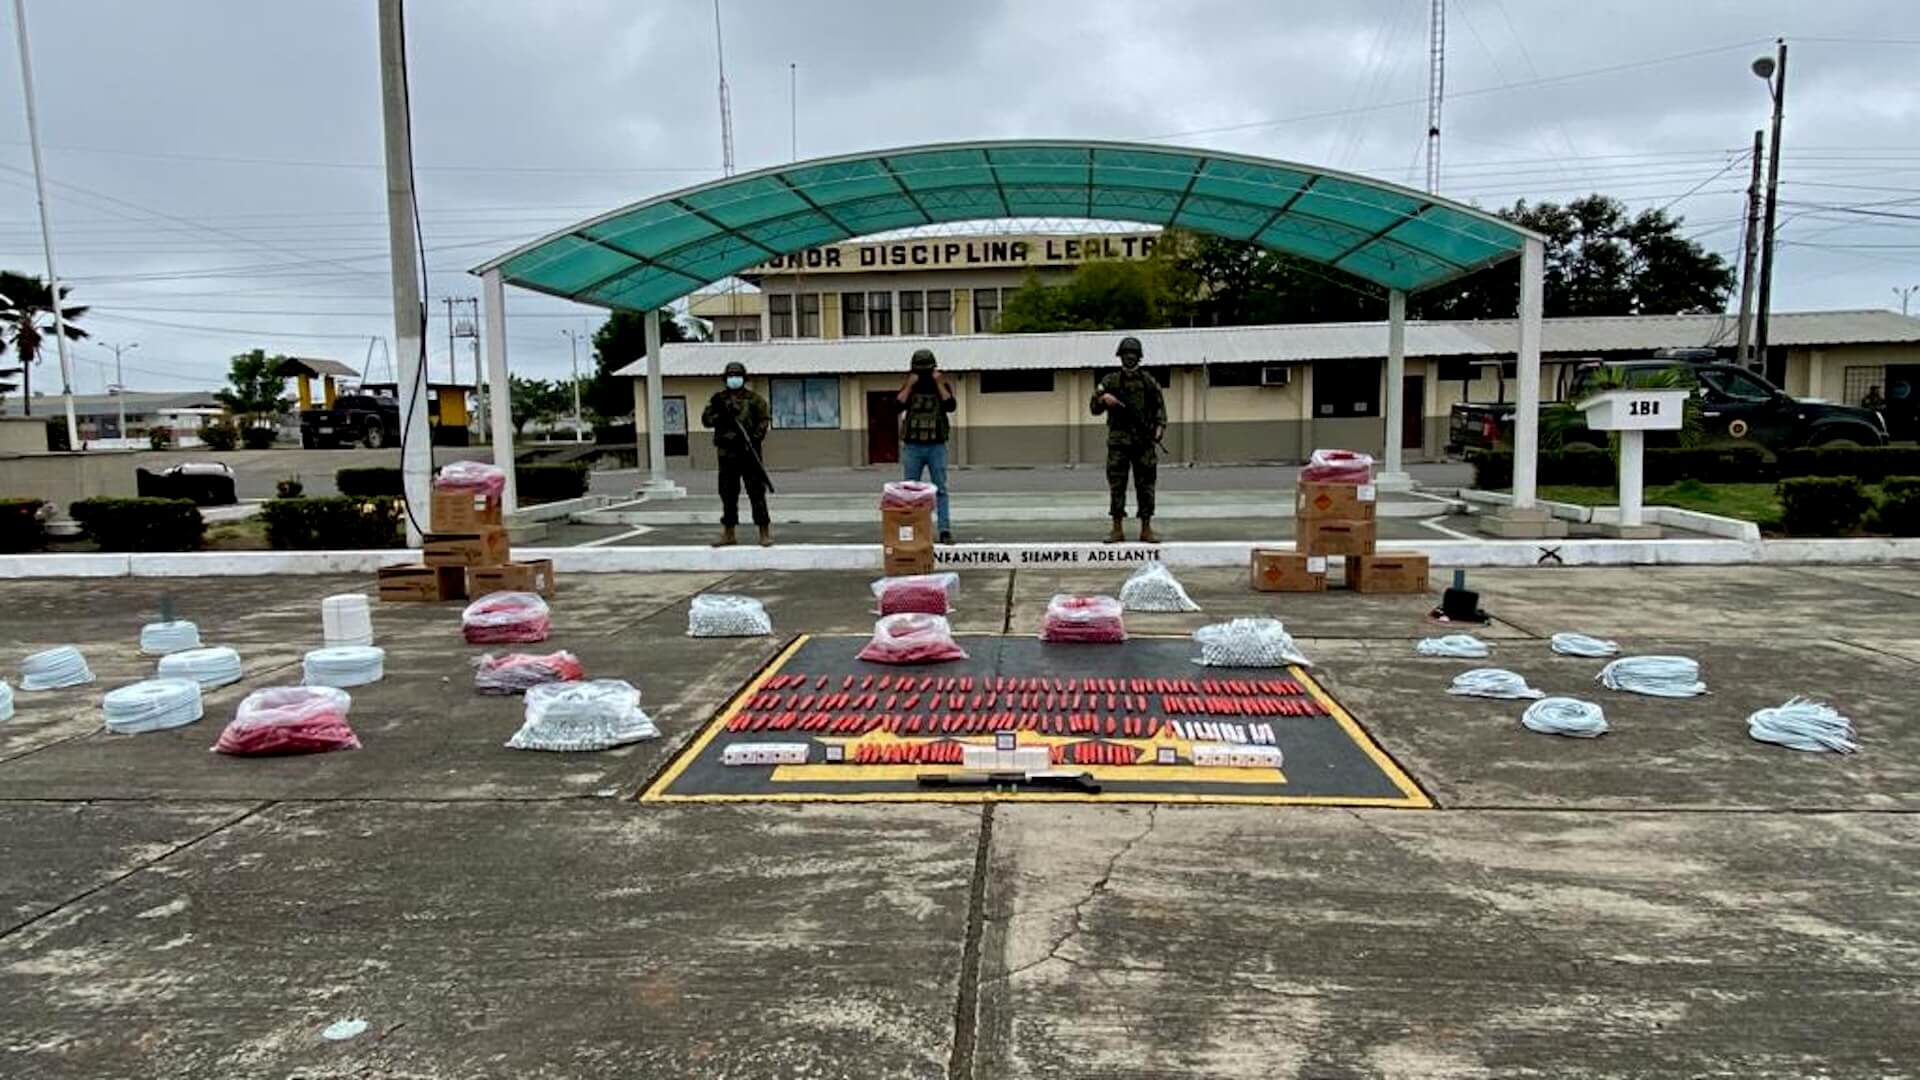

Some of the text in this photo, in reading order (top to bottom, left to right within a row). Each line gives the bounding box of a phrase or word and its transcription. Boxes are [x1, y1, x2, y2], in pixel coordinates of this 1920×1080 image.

[759, 236, 1168, 268] ONOR DISCIPLINA LEALTA
[932, 549, 1161, 563] NFANTERIA SIEMPRE ADELANTE
